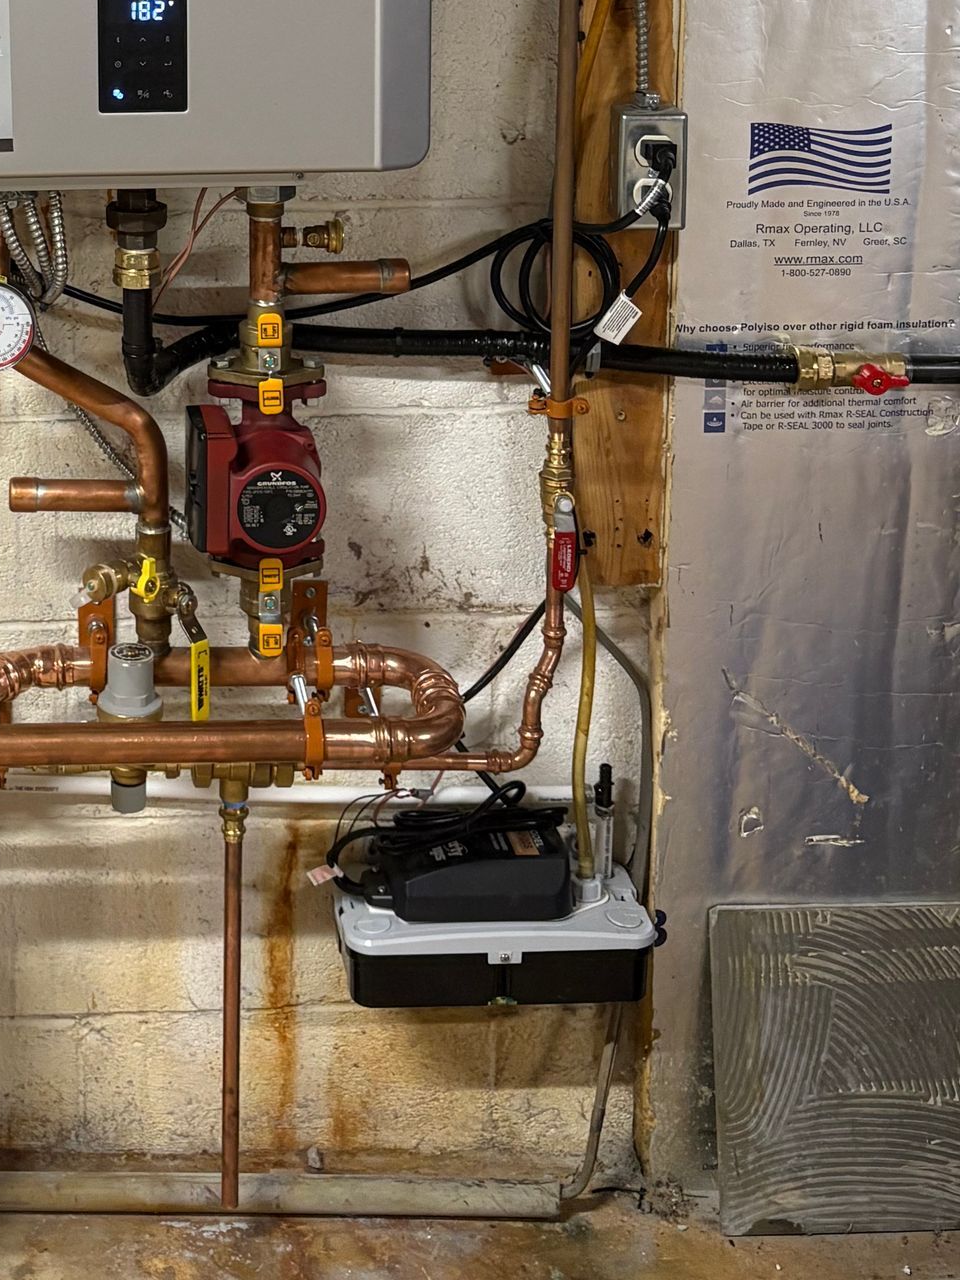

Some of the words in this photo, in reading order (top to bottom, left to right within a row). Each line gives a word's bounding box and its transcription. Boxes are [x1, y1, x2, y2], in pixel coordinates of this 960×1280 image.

[727, 201, 759, 209] Proudly
[761, 200, 785, 208] Made
[788, 200, 804, 208] and
[807, 200, 856, 211] Engineered
[884, 198, 911, 206] U.S.A.
[756, 224, 790, 233] Rmax
[794, 223, 854, 235] Operating,
[859, 222, 882, 232] LLC
[730, 239, 759, 248] Dallas,
[763, 239, 775, 247] TX
[795, 238, 829, 248] Fernley,
[833, 238, 846, 246] NV
[863, 237, 890, 246] Greer,
[892, 237, 907, 246] SC
[774, 254, 863, 265] www.rmax.com
[782, 268, 851, 277] 1-800-527-0890
[699, 324, 738, 333] choose
[740, 323, 779, 334] Polyiso
[809, 322, 837, 330] other
[840, 321, 864, 332] rigid
[867, 321, 894, 329] foam
[896, 319, 956, 329] insulation?
[744, 387, 755, 396] for
[741, 400, 753, 408] Air
[756, 398, 785, 407] barrier
[788, 398, 800, 407] for
[802, 399, 845, 407] additional
[848, 398, 881, 406] thermal
[883, 396, 916, 406] comfort
[741, 410, 757, 419] Can
[760, 411, 771, 420] be
[774, 410, 795, 419] used
[797, 411, 817, 419] with
[846, 410, 877, 418] R-SEAL
[742, 422, 763, 431] Tape
[778, 422, 809, 430] R-SEAL
[812, 421, 833, 429] 3000
[848, 420, 865, 429] seal
[867, 421, 893, 430] joints.
